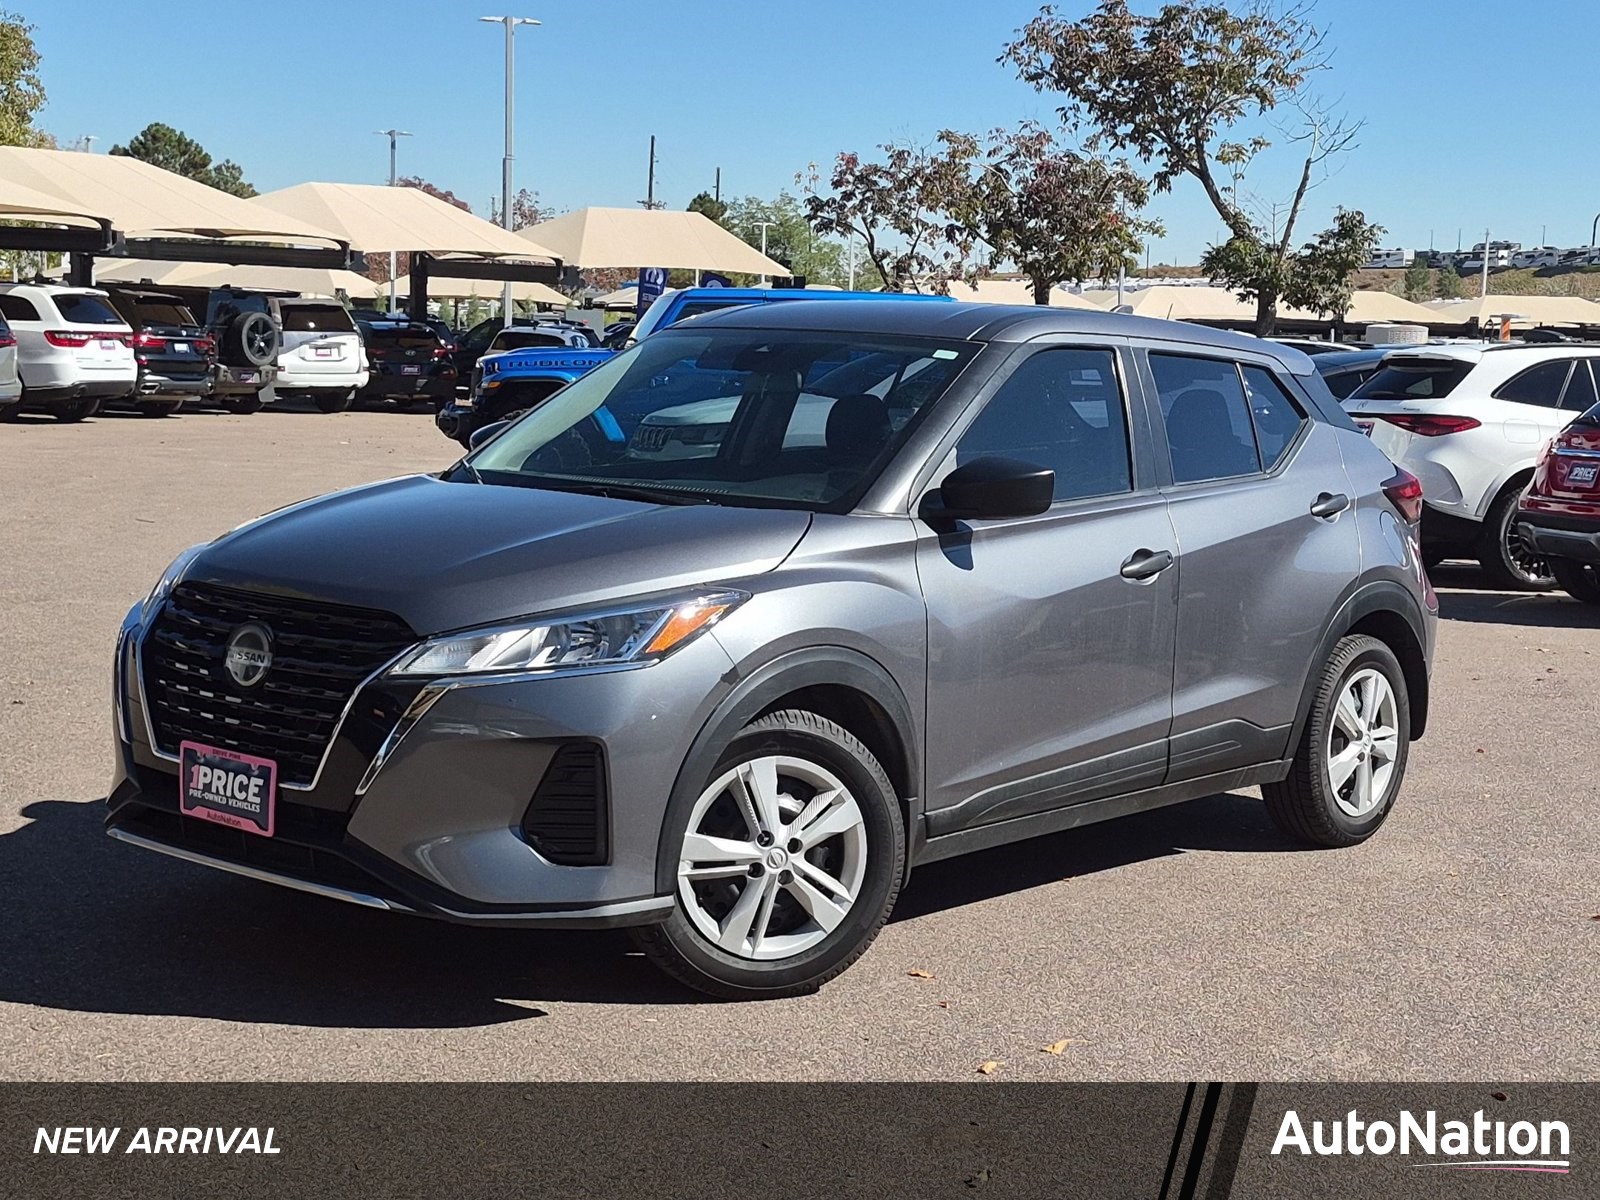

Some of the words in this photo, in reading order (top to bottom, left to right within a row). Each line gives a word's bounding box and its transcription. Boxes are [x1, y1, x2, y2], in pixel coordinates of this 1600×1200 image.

[508, 359, 604, 368] RUBICON
[229, 651, 265, 663] SSAN
[189, 764, 264, 804] 1PRICE
[189, 788, 227, 805] PRE-OWNED
[228, 798, 261, 813] VEHICLES
[207, 811, 242, 827] AutoNation
